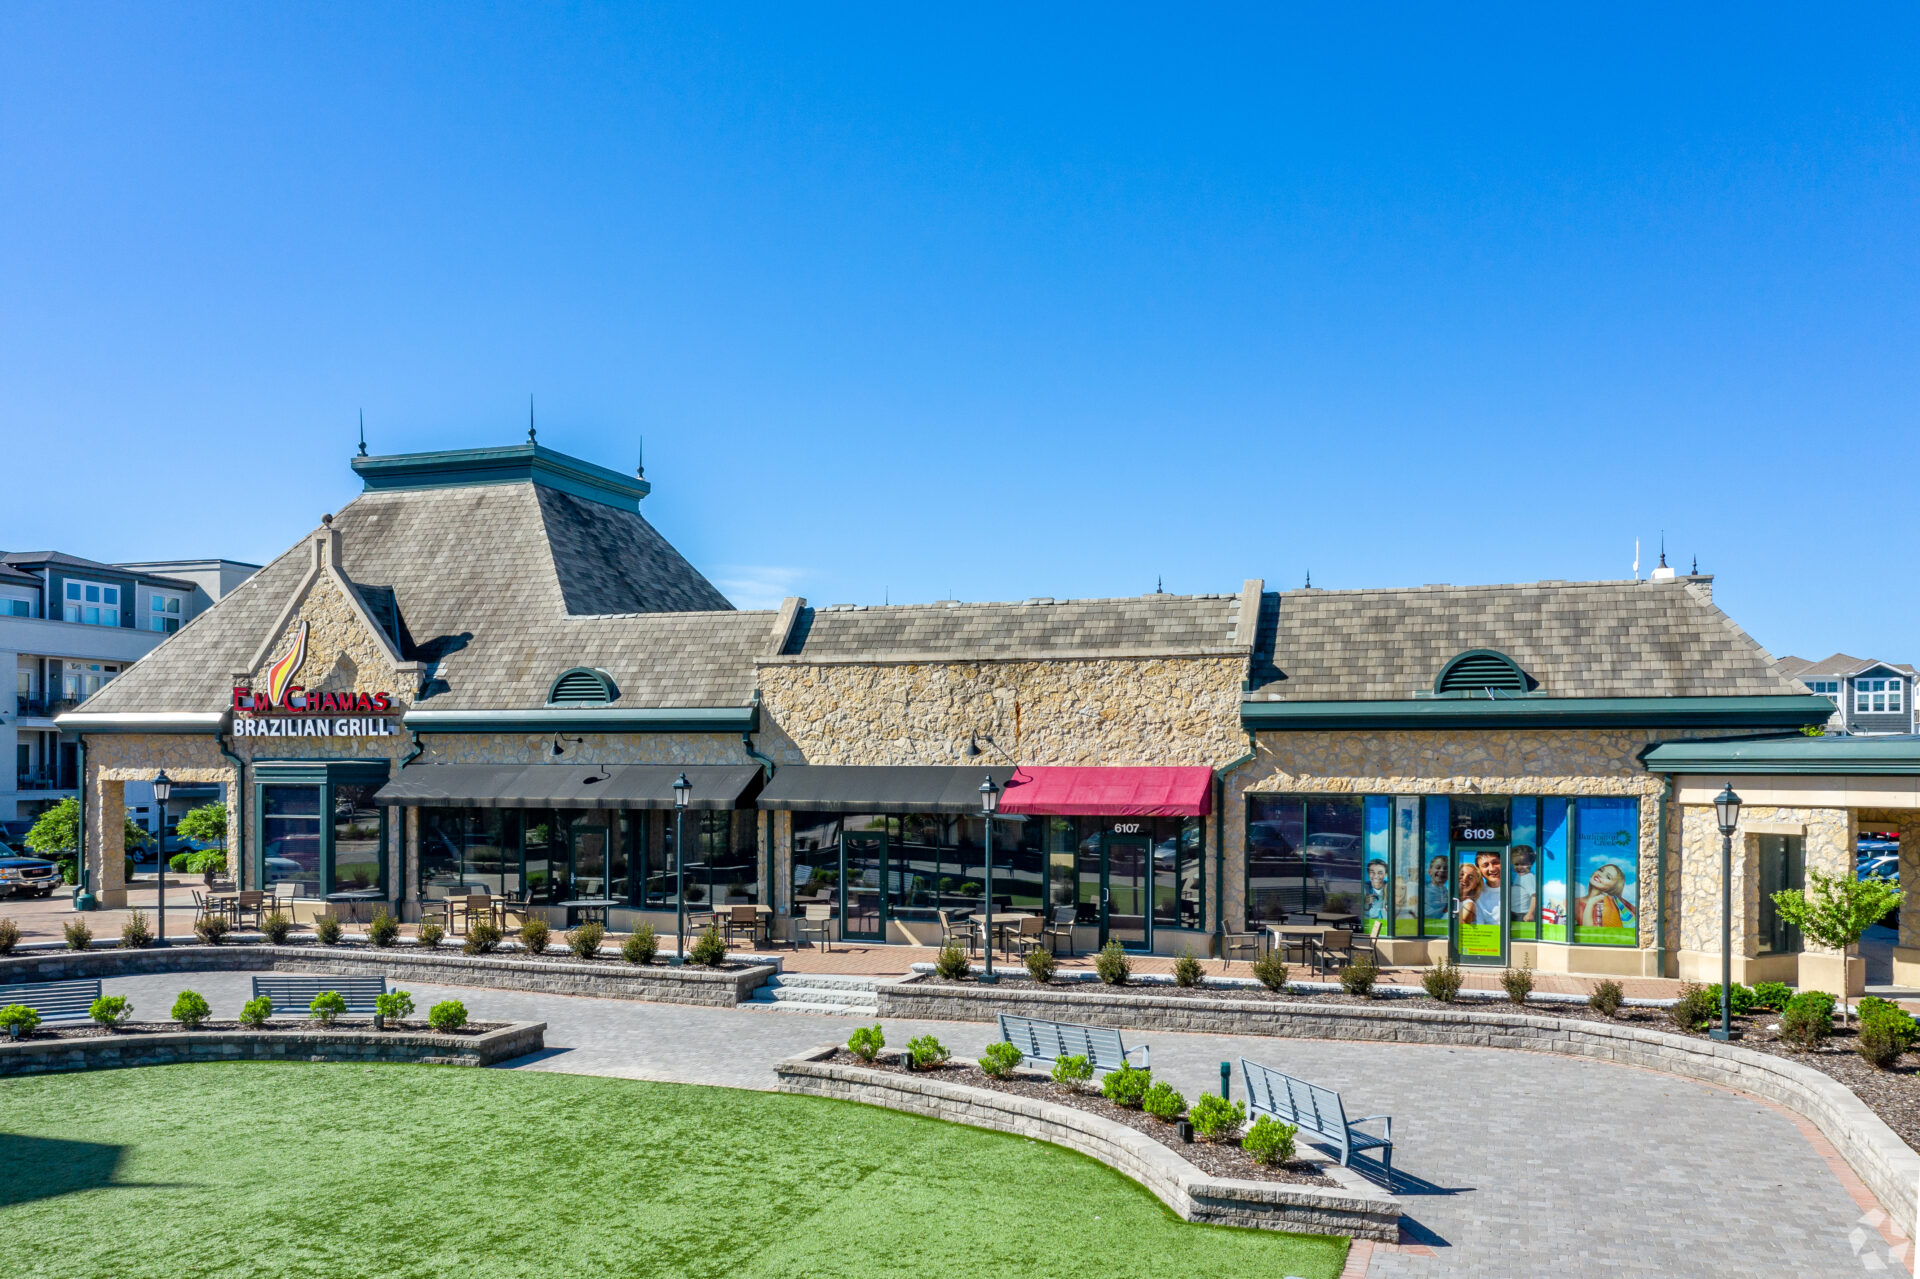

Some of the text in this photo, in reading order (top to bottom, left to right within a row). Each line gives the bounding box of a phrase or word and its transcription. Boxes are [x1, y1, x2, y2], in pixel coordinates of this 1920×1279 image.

[233, 686, 389, 712] EM CHAMAS
[233, 718, 389, 737] BRAZILIAN GRILL
[1114, 823, 1140, 834] 6107
[1464, 828, 1495, 840] 6109
